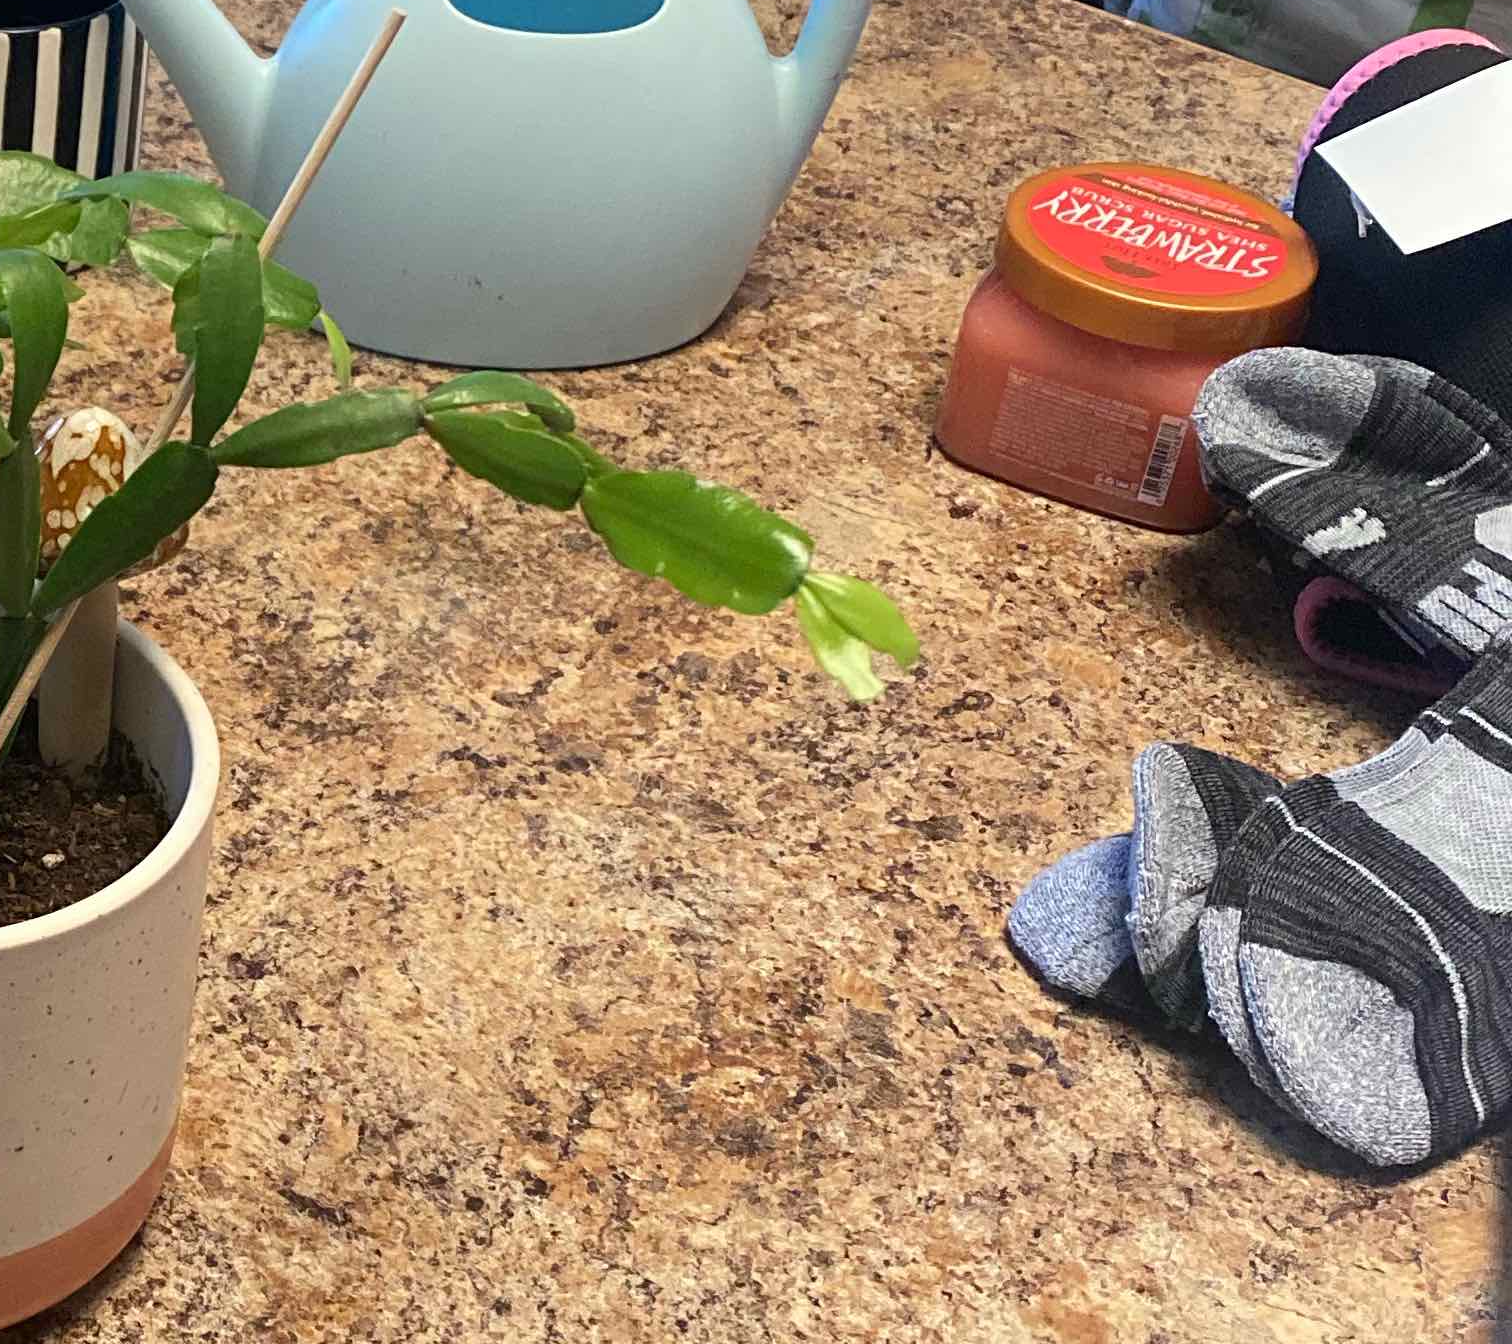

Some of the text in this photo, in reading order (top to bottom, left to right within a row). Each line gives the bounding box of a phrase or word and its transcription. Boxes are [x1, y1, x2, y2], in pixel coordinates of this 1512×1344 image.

[1071, 185, 1135, 214] SCRUB
[1031, 190, 1279, 278] STRAWBERRY
[1141, 209, 1209, 236] SUGAR
[1216, 231, 1269, 252] SHEA
